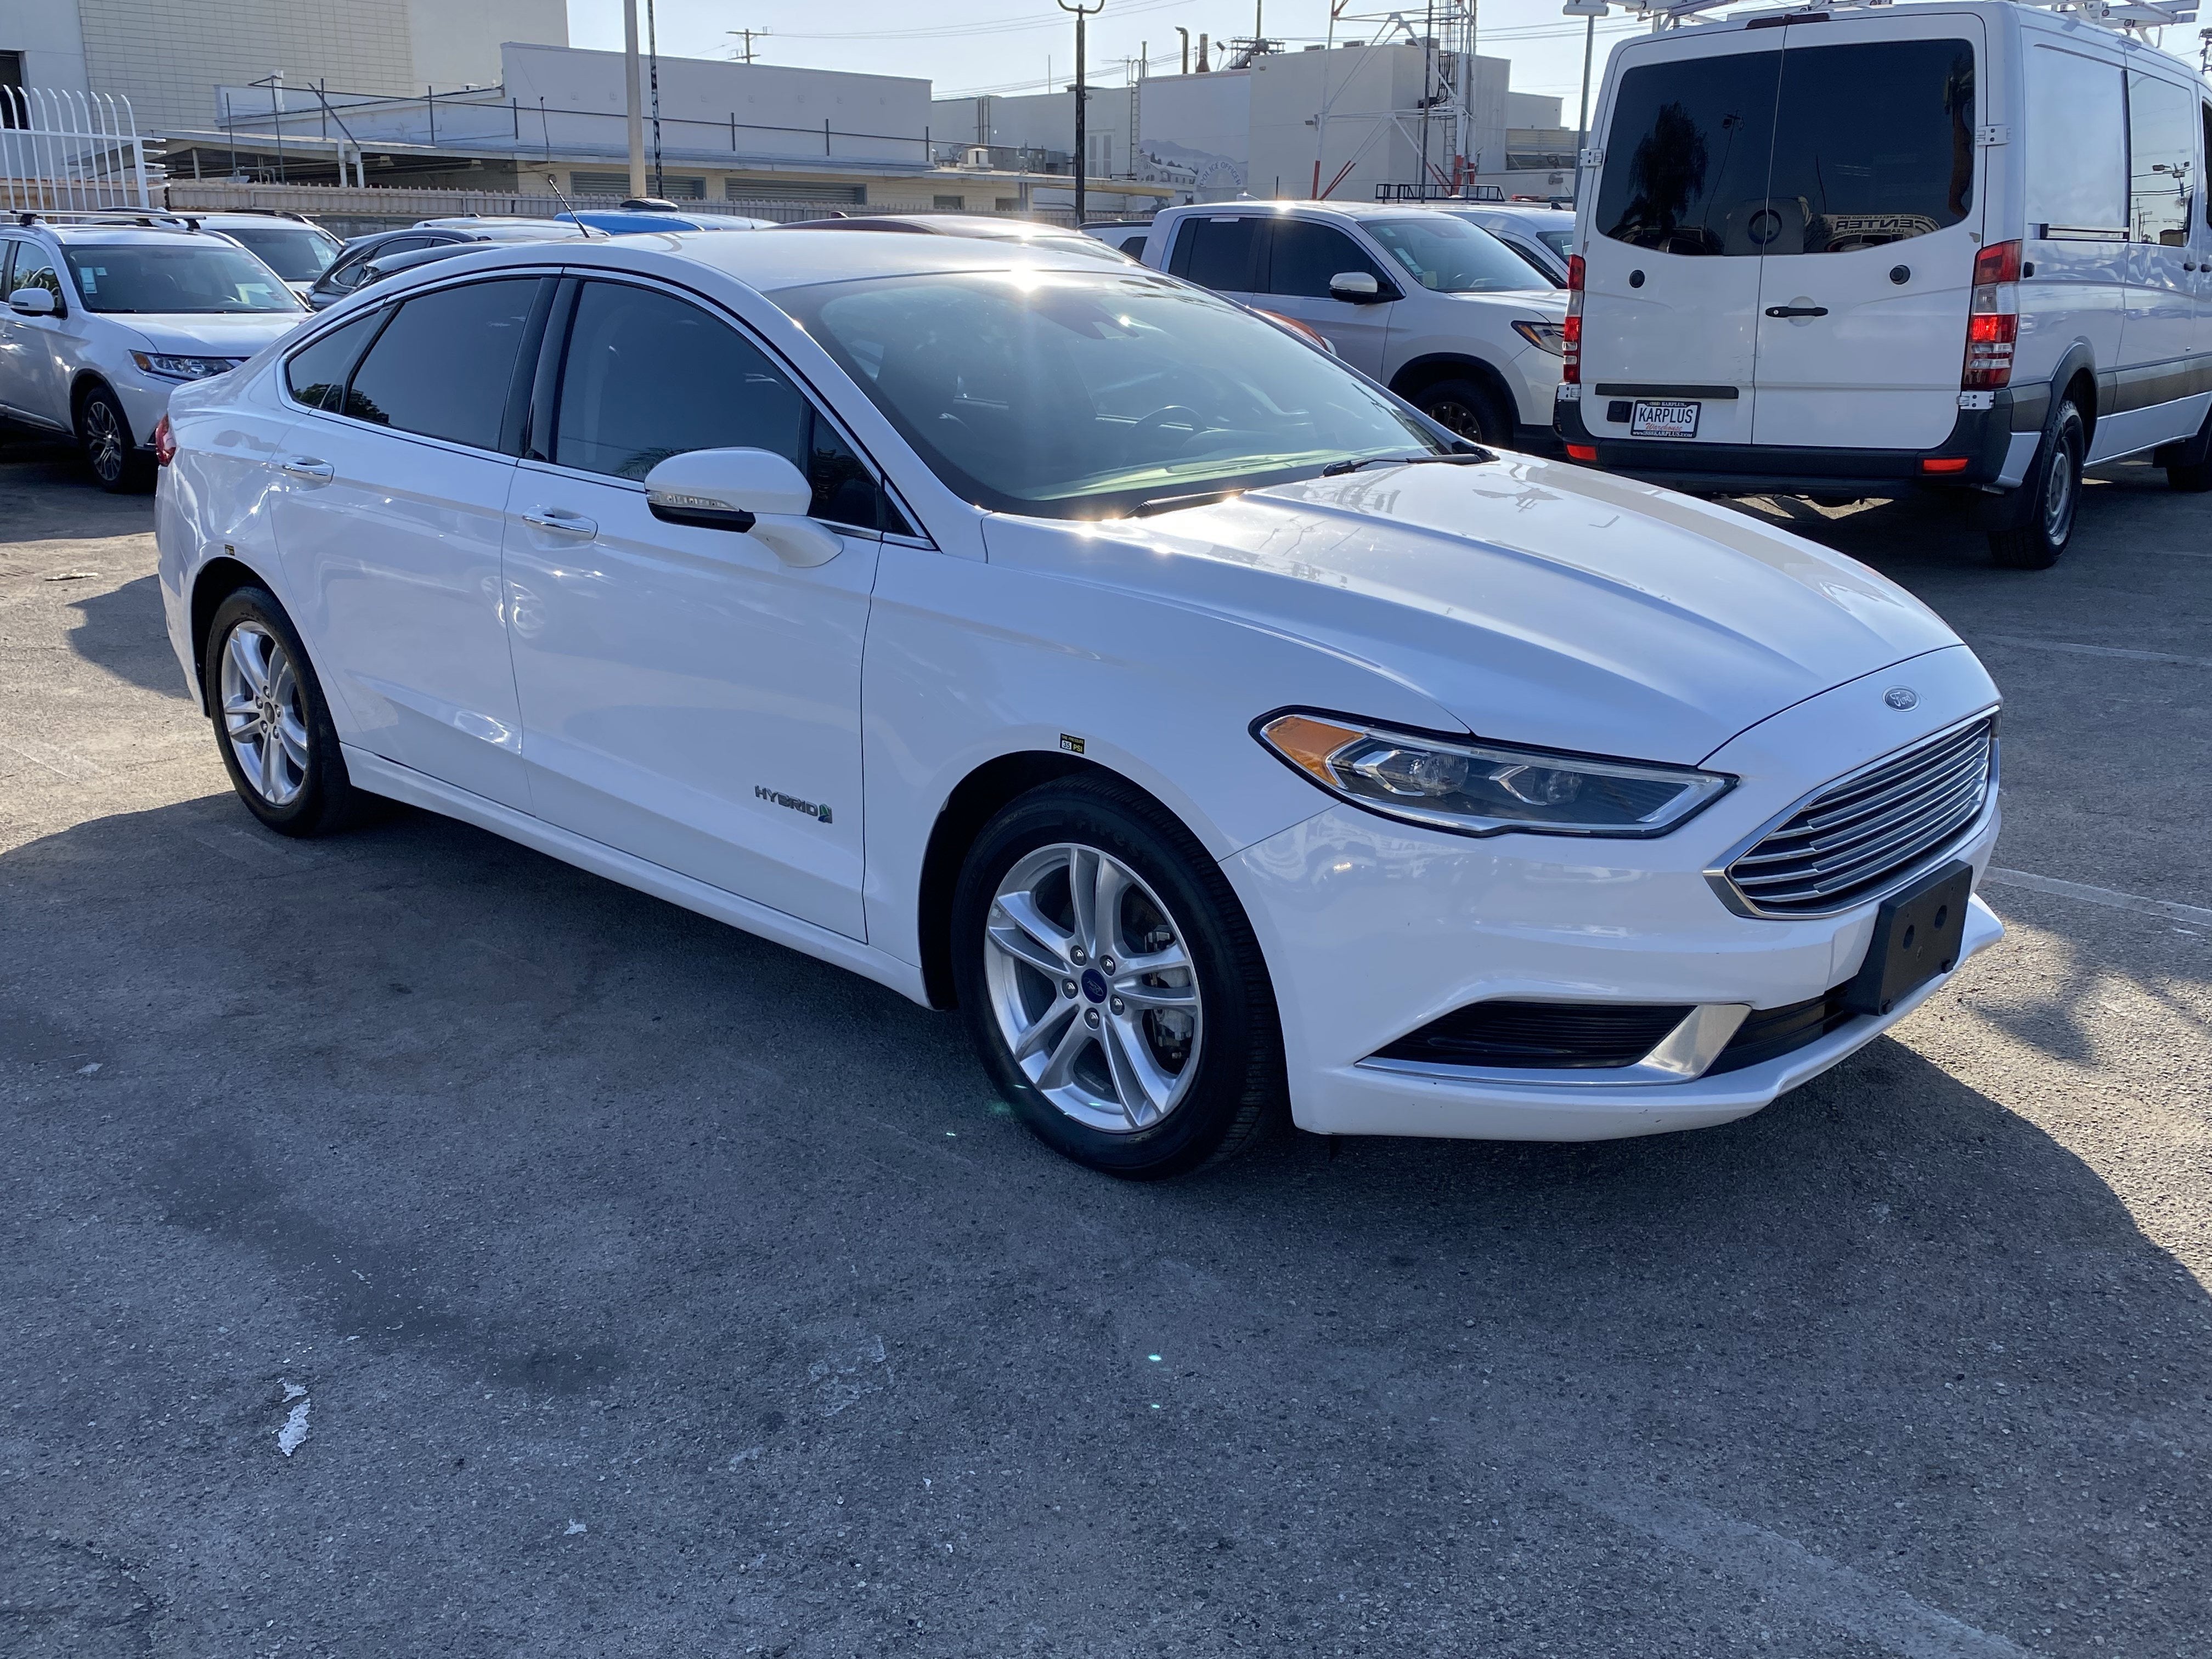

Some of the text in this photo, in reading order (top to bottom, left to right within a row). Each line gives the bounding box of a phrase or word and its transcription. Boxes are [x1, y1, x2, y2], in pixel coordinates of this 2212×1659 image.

[1199, 162, 1241, 185] POLICE OFFICER
[1639, 407, 1693, 424] KARPLUS
[1646, 422, 1683, 431] Warehouse
[1073, 743, 1083, 752] PSI
[754, 785, 818, 817] HYBRID
